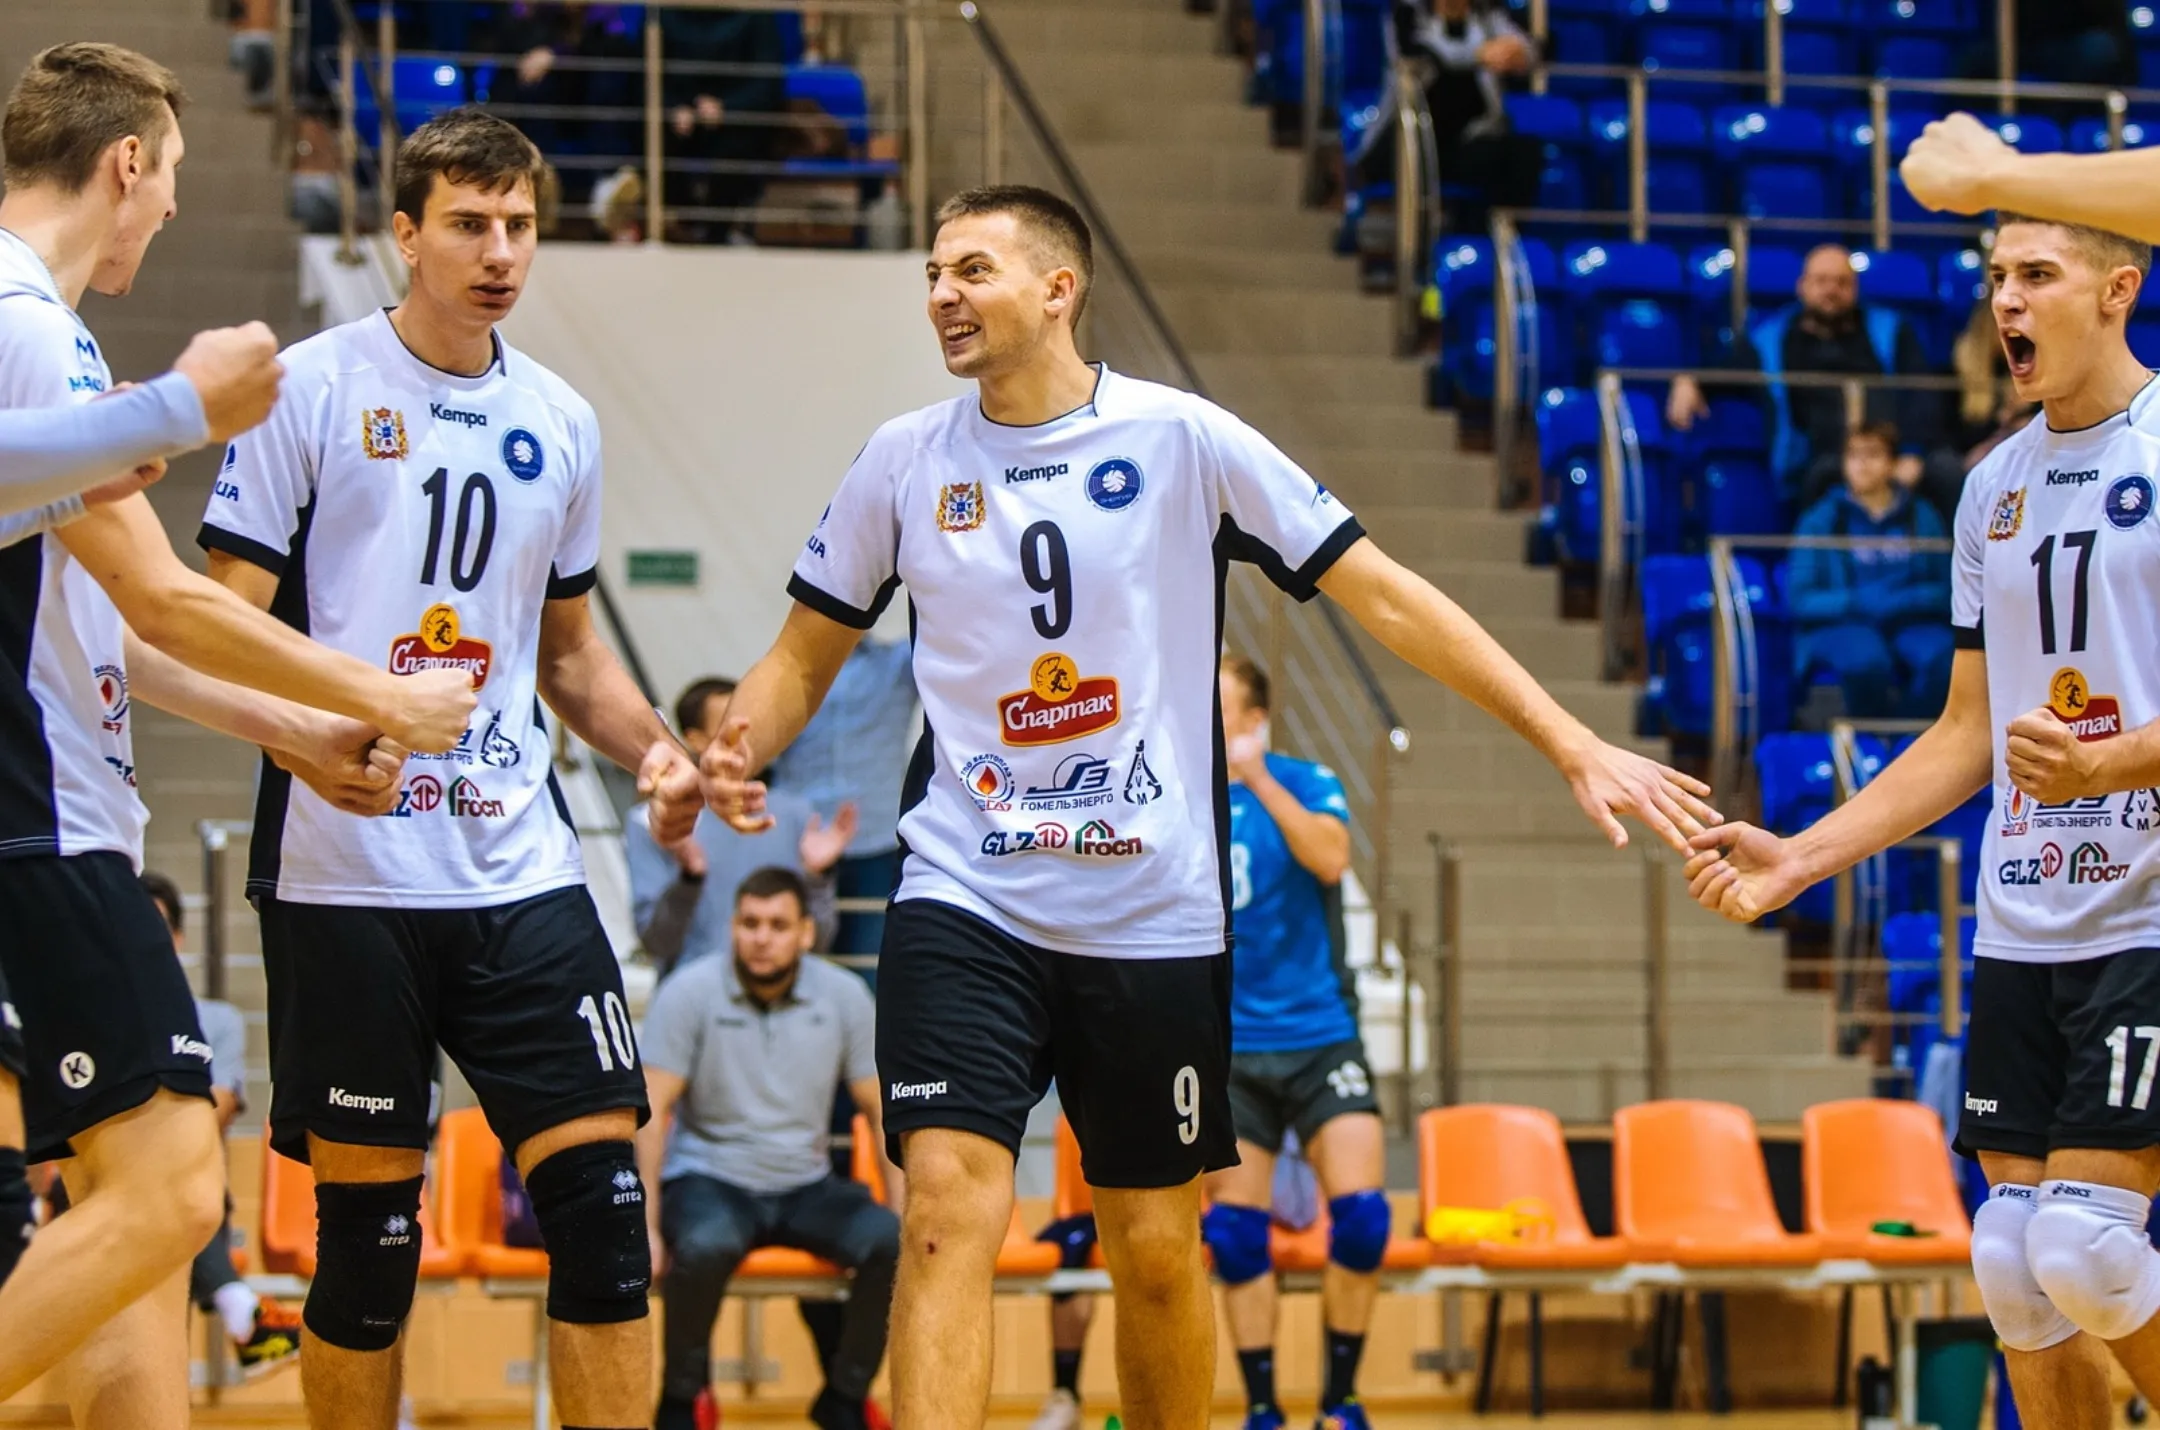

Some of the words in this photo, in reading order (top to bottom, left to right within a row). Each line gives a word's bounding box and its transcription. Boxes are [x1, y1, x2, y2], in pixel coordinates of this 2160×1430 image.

[430, 403, 487, 428] Kempa
[1005, 463, 1069, 484] Kempa
[2046, 469, 2099, 488] Kempa
[420, 467, 497, 593] 10
[1019, 520, 1073, 640] 9
[2030, 529, 2098, 655] 17
[1005, 694, 1114, 731] Спартак
[1020, 793, 1114, 811] ГОМЕЛЬЭНЕРГО
[981, 831, 1036, 856] GLZ
[1999, 859, 2041, 885] GLZ
[577, 991, 634, 1072] 10
[2104, 1025, 2160, 1110] 17
[328, 1087, 394, 1114] Kempa
[891, 1080, 947, 1100] Kempa
[1173, 1065, 1199, 1144] 9
